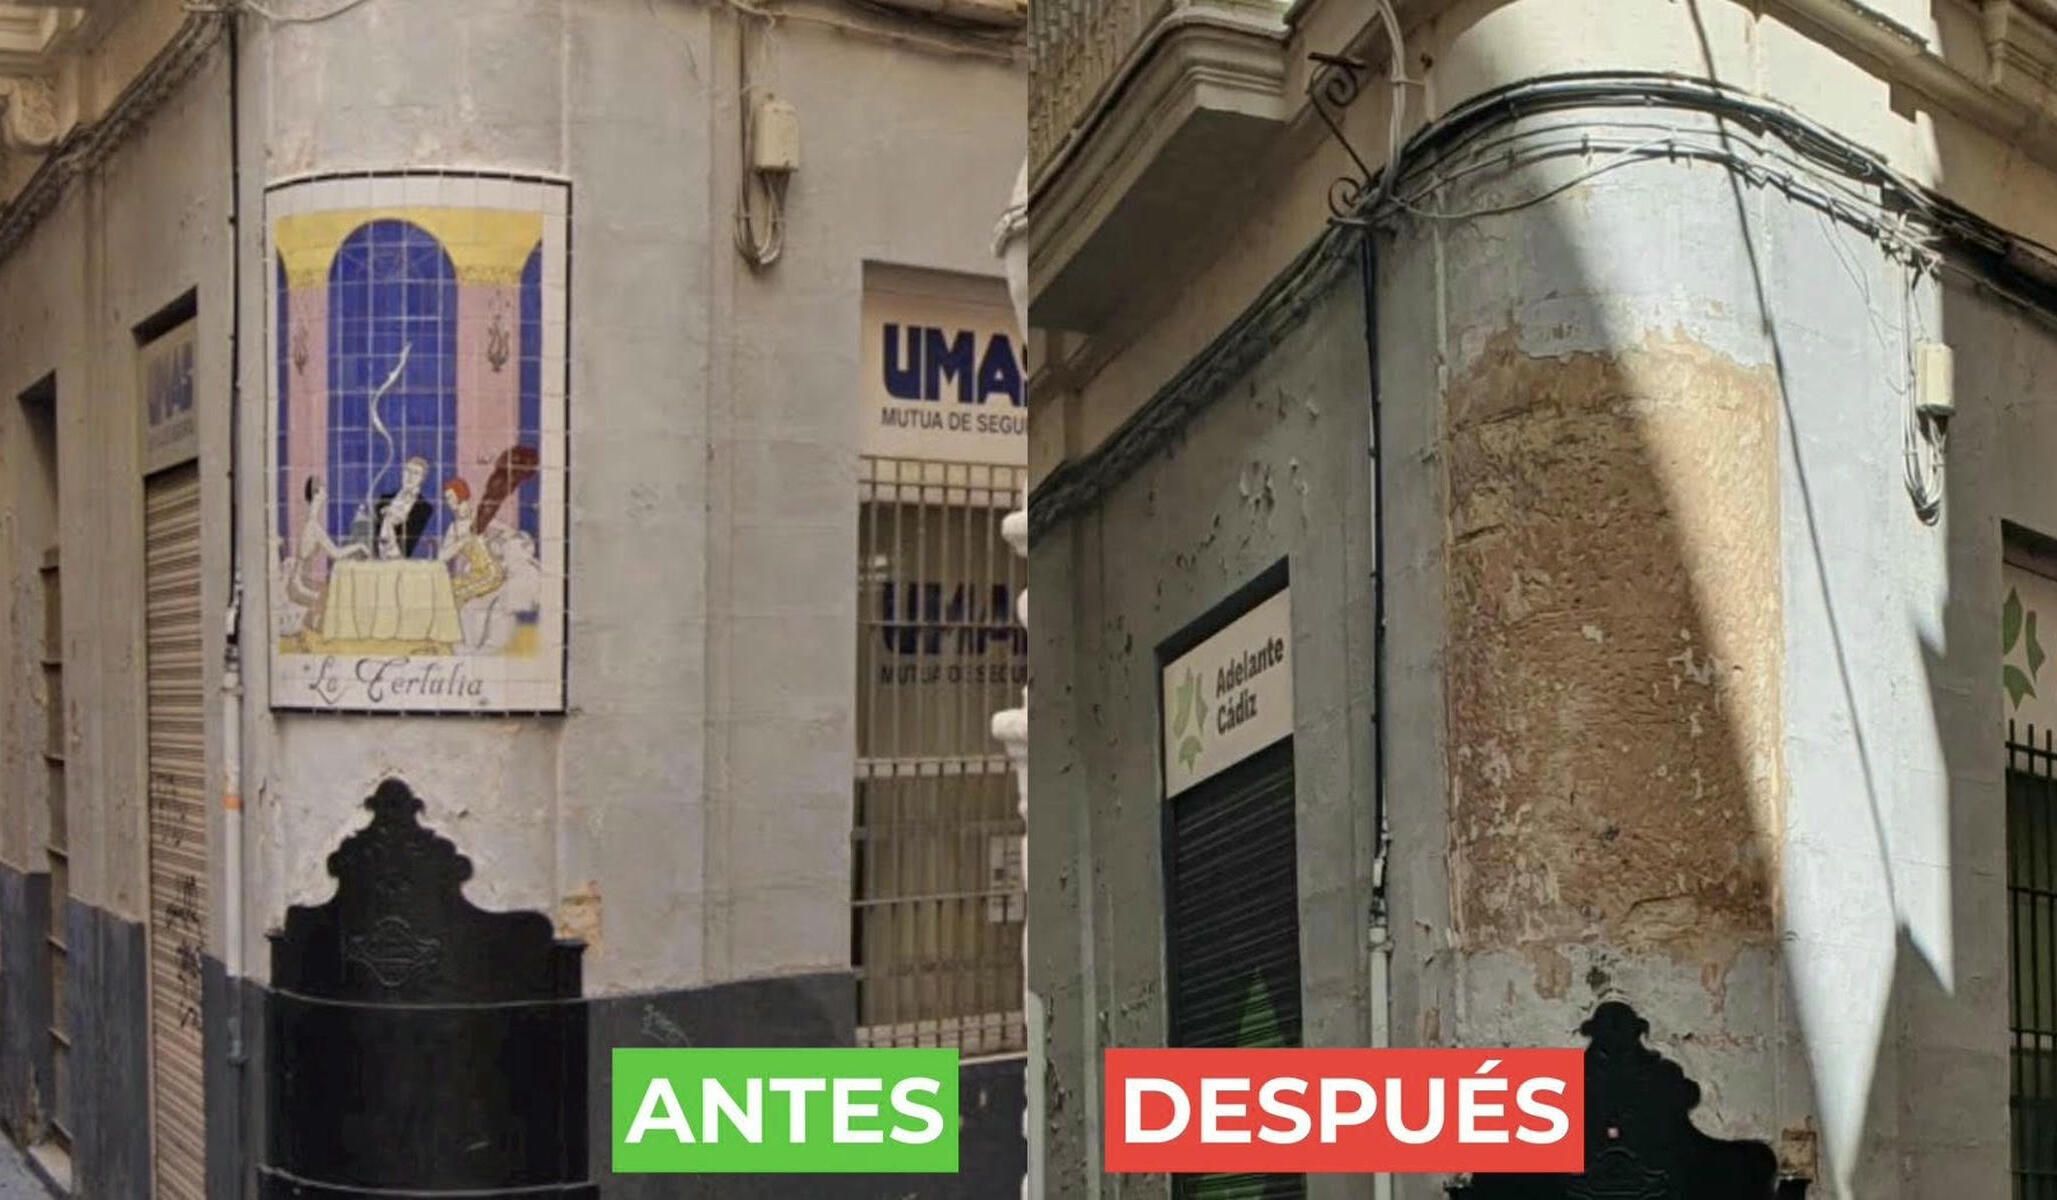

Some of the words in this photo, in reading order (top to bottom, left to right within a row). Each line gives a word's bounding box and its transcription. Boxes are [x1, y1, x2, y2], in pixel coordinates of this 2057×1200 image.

[883, 323, 1028, 408] UMA
[882, 406, 943, 430] MUTUA
[950, 412, 973, 432] DE
[976, 413, 1028, 436] SEGU
[882, 581, 1028, 656] UMA
[1216, 636, 1284, 699] Adelante
[1216, 688, 1258, 735] Cádiz
